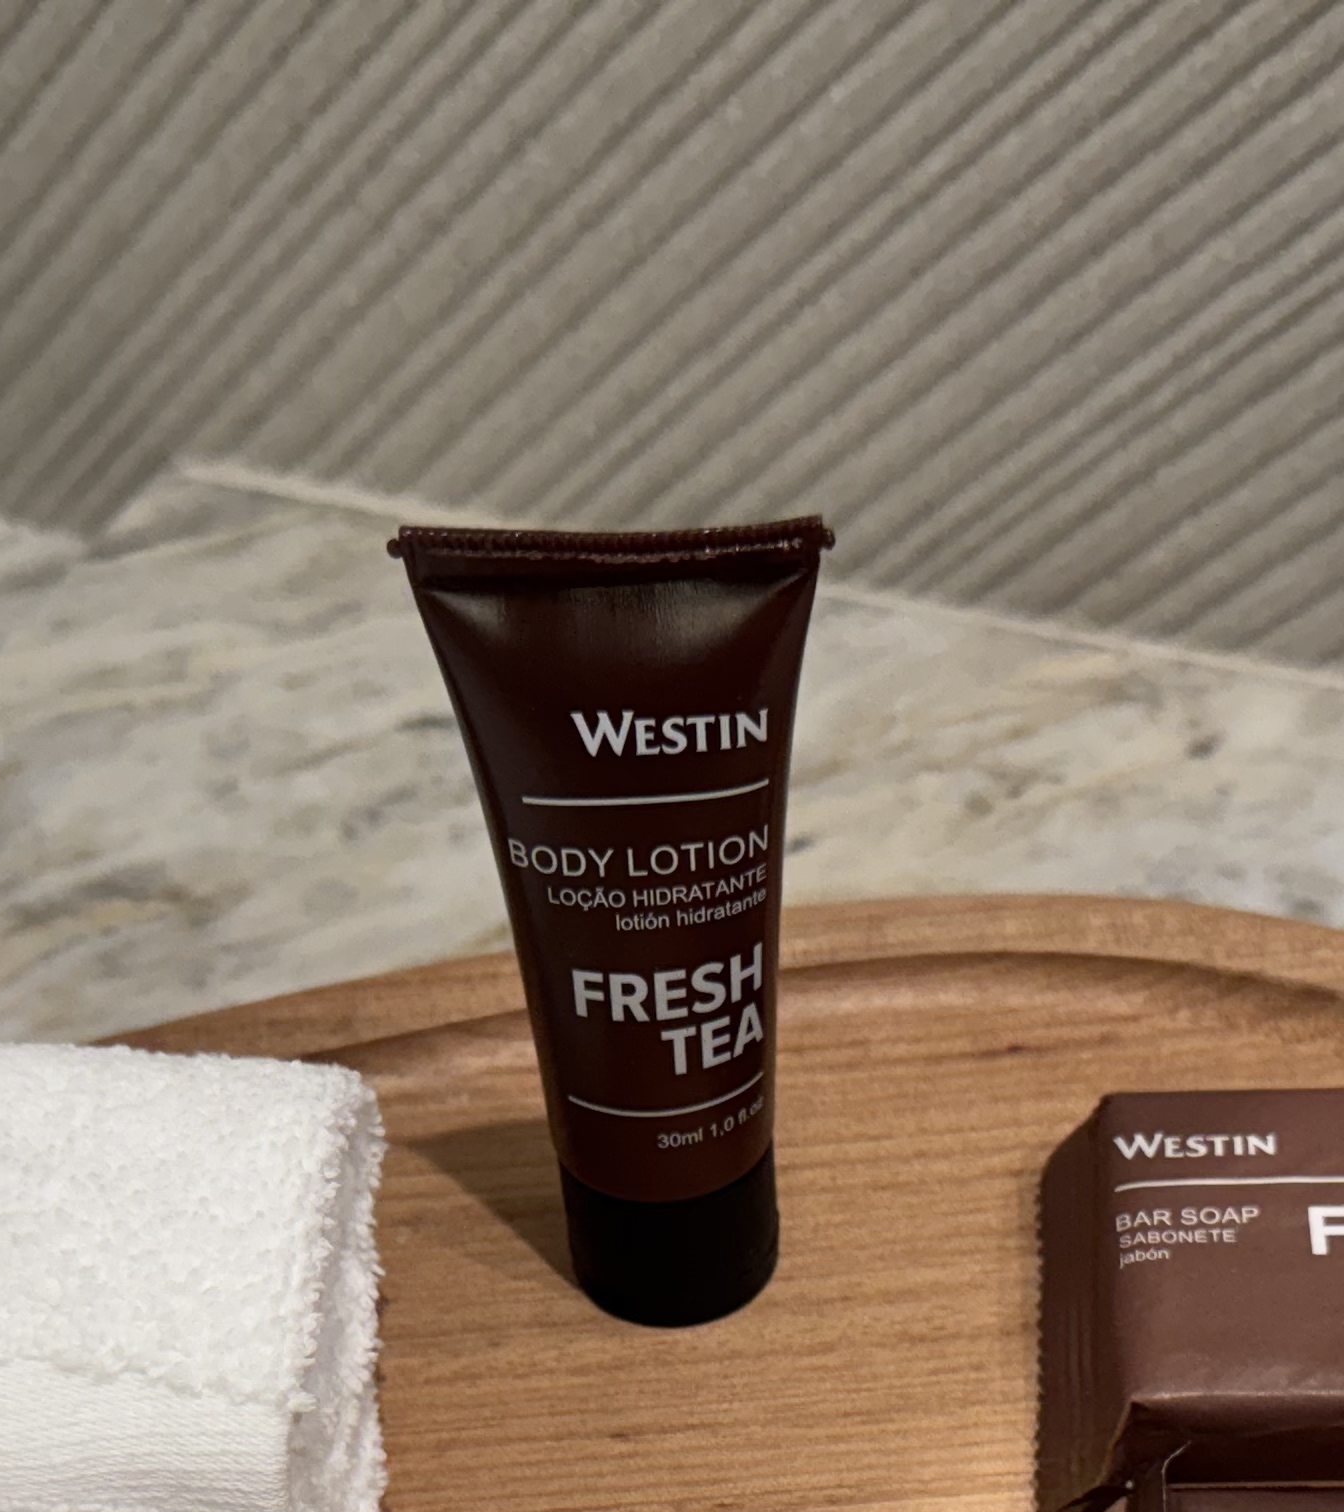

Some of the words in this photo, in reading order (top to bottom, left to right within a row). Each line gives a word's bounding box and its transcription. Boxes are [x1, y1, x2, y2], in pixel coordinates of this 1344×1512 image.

[570, 708, 769, 758] WESTIN
[507, 837, 614, 878] BODY
[627, 824, 769, 877] LOTION
[547, 886, 626, 911] LOÇÃO
[632, 862, 767, 908] HIDRATANTE
[615, 912, 670, 931] lotión
[676, 886, 767, 927] hidratante
[571, 942, 764, 1023] FRESH
[661, 1003, 764, 1076] TEA
[657, 1127, 703, 1149] 30ml
[1113, 1133, 1278, 1161] WESTIN
[1115, 1209, 1172, 1232] BAR
[1180, 1206, 1260, 1226] SOAP
[1119, 1229, 1237, 1248] SABONETE
[1119, 1248, 1171, 1269] jabón
